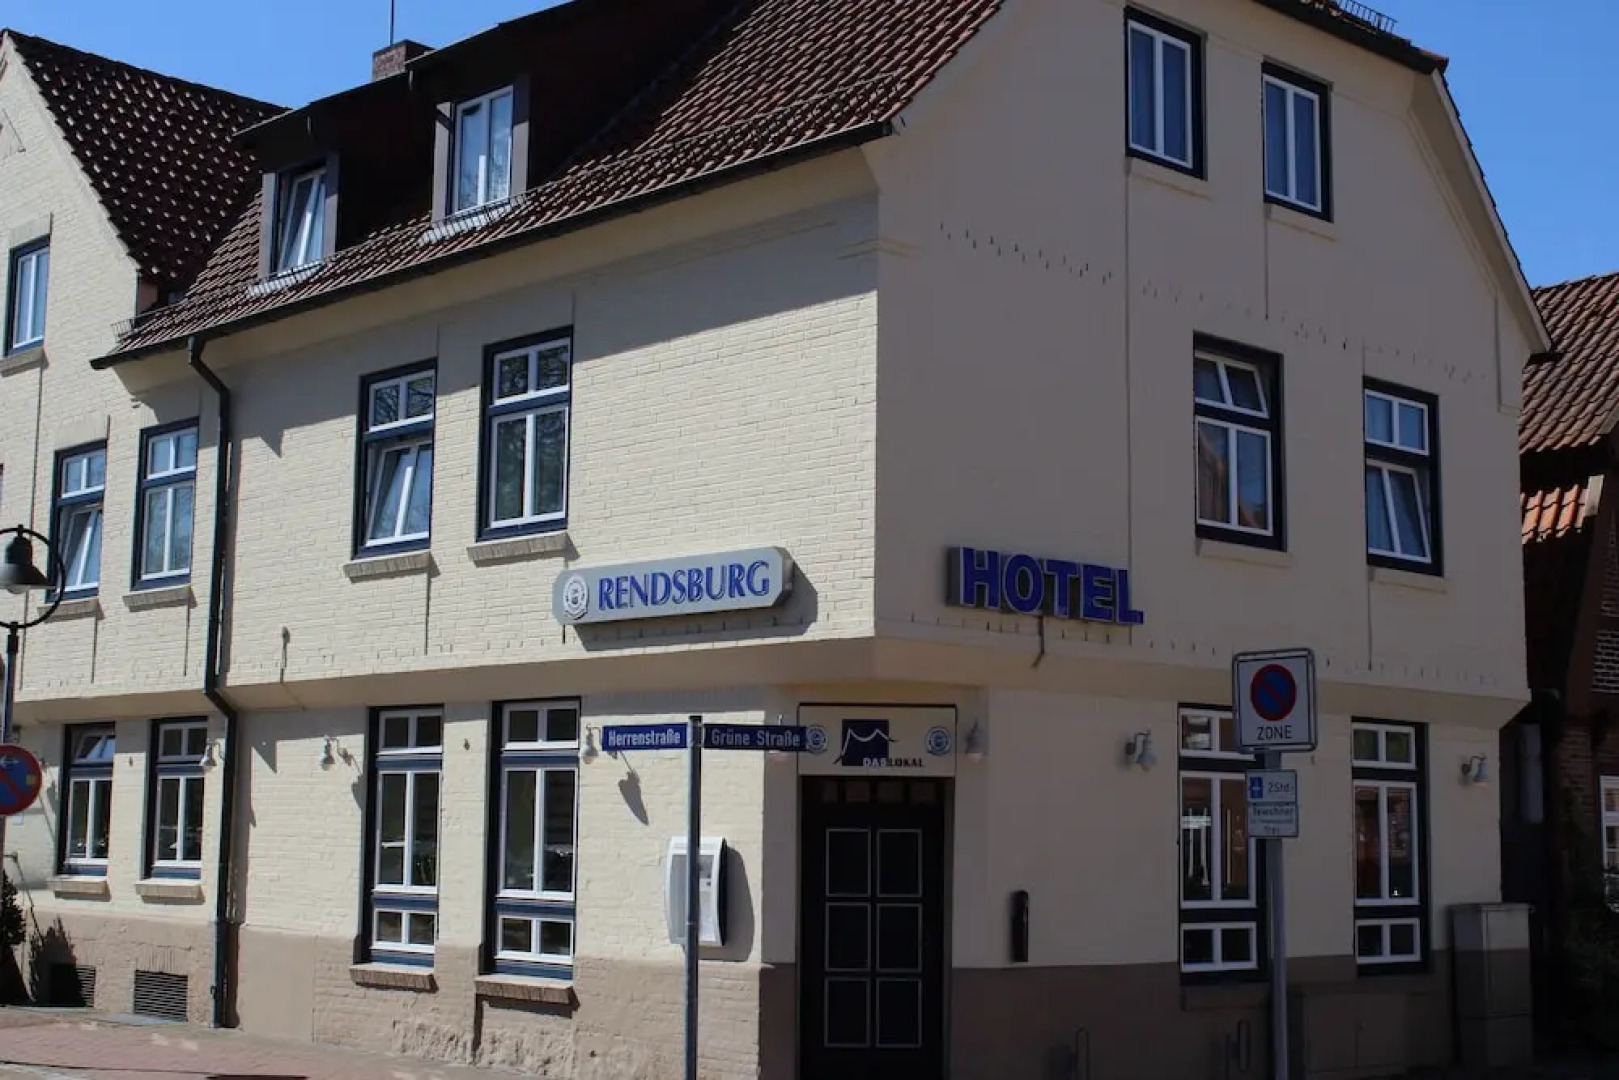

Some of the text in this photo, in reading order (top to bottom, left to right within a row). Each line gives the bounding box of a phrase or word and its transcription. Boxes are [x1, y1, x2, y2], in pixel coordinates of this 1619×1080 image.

[599, 560, 770, 611] RENDSBURG
[960, 547, 1144, 625] HOTEL
[608, 728, 681, 747] Herrenstraße
[711, 729, 750, 746] Grüne
[757, 729, 800, 746] Straße
[1257, 725, 1292, 740] ZONE
